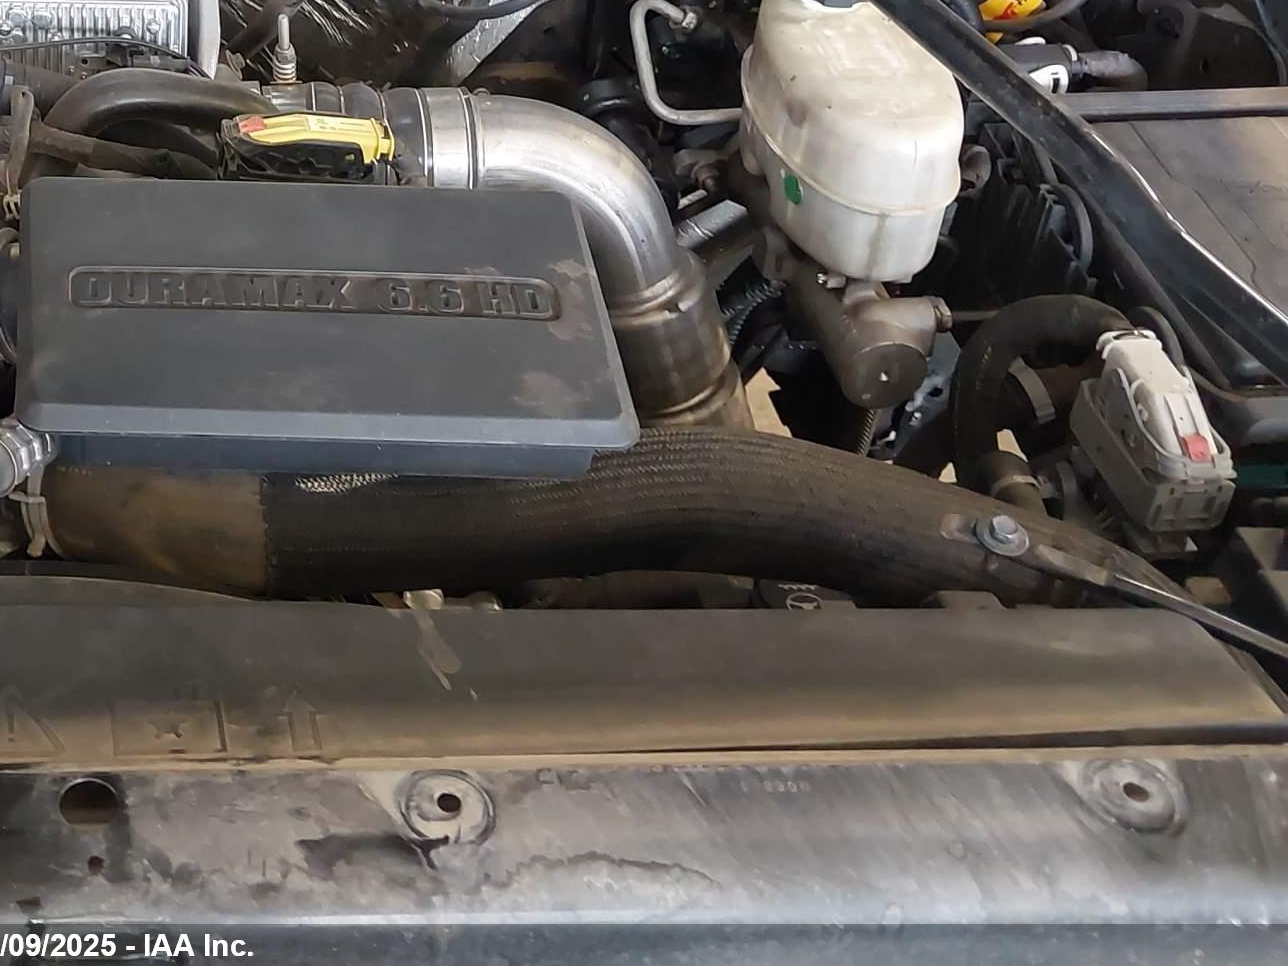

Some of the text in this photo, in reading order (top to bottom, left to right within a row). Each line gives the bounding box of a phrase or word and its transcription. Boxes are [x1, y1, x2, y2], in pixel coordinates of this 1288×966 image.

[75, 271, 555, 318] DURAMAX 6.6 HD
